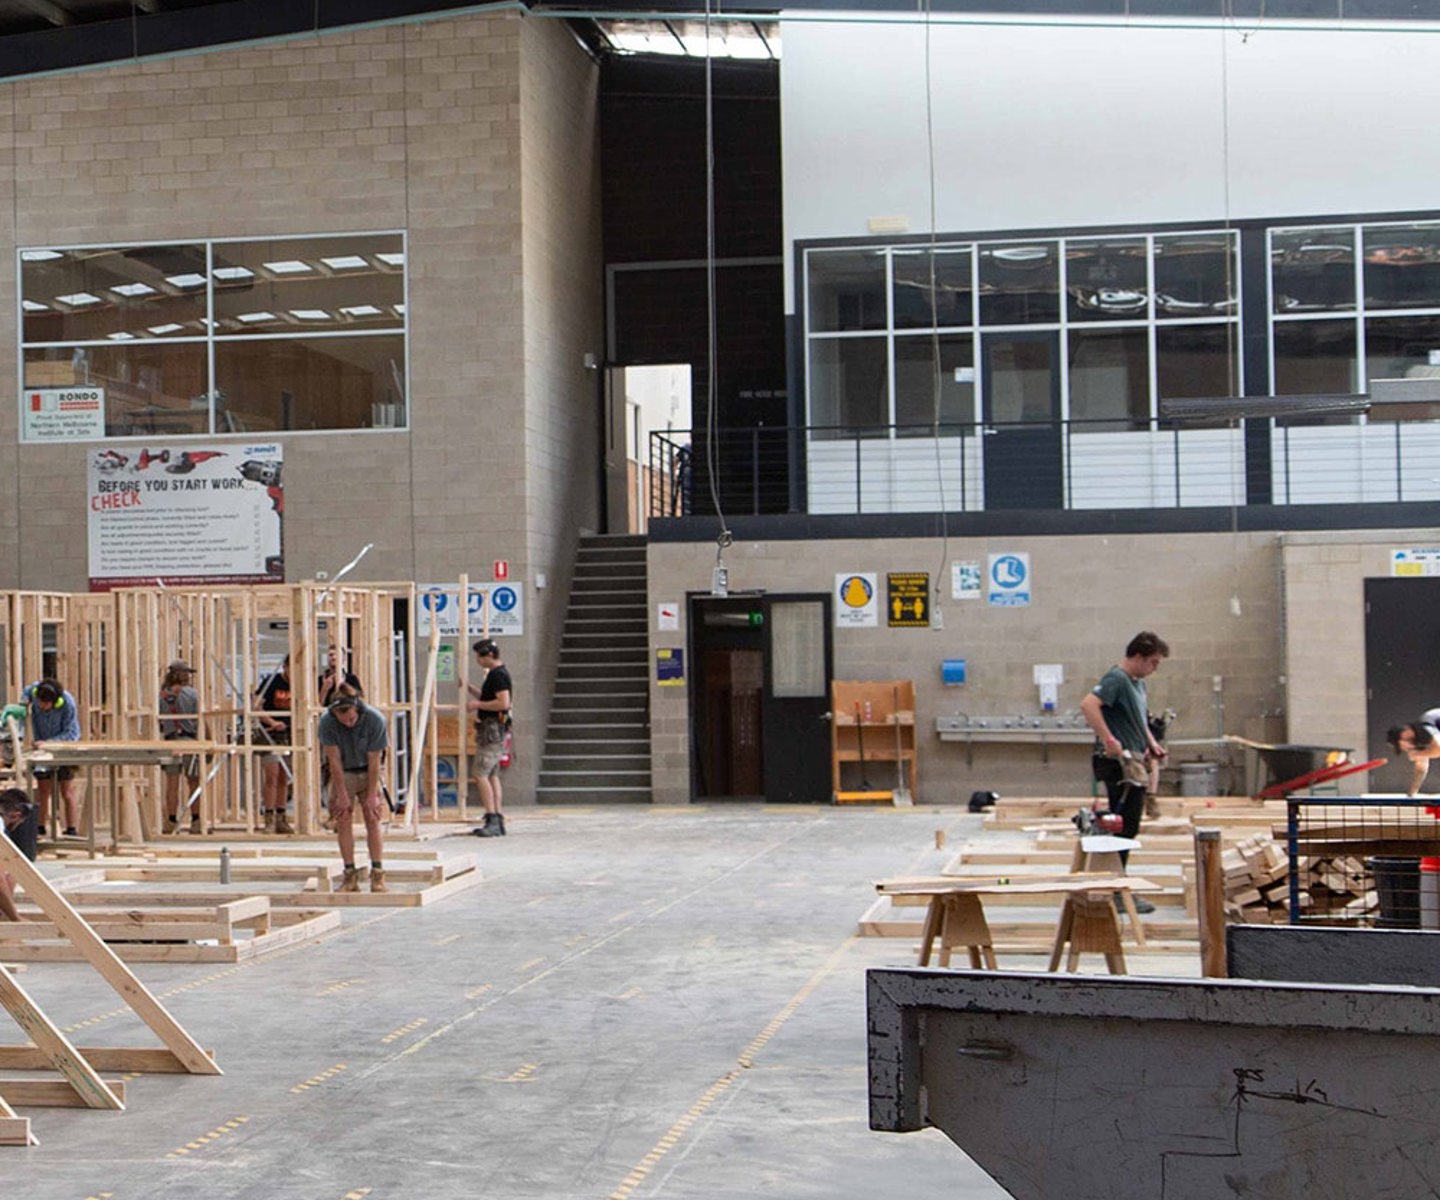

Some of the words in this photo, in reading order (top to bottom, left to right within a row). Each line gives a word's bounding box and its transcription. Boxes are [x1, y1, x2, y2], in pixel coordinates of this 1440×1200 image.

[59, 392, 98, 400] RONDO
[98, 480, 141, 492] BEFORE
[144, 479, 168, 492] YOU
[172, 479, 206, 491] START
[91, 491, 142, 511] CHECK
